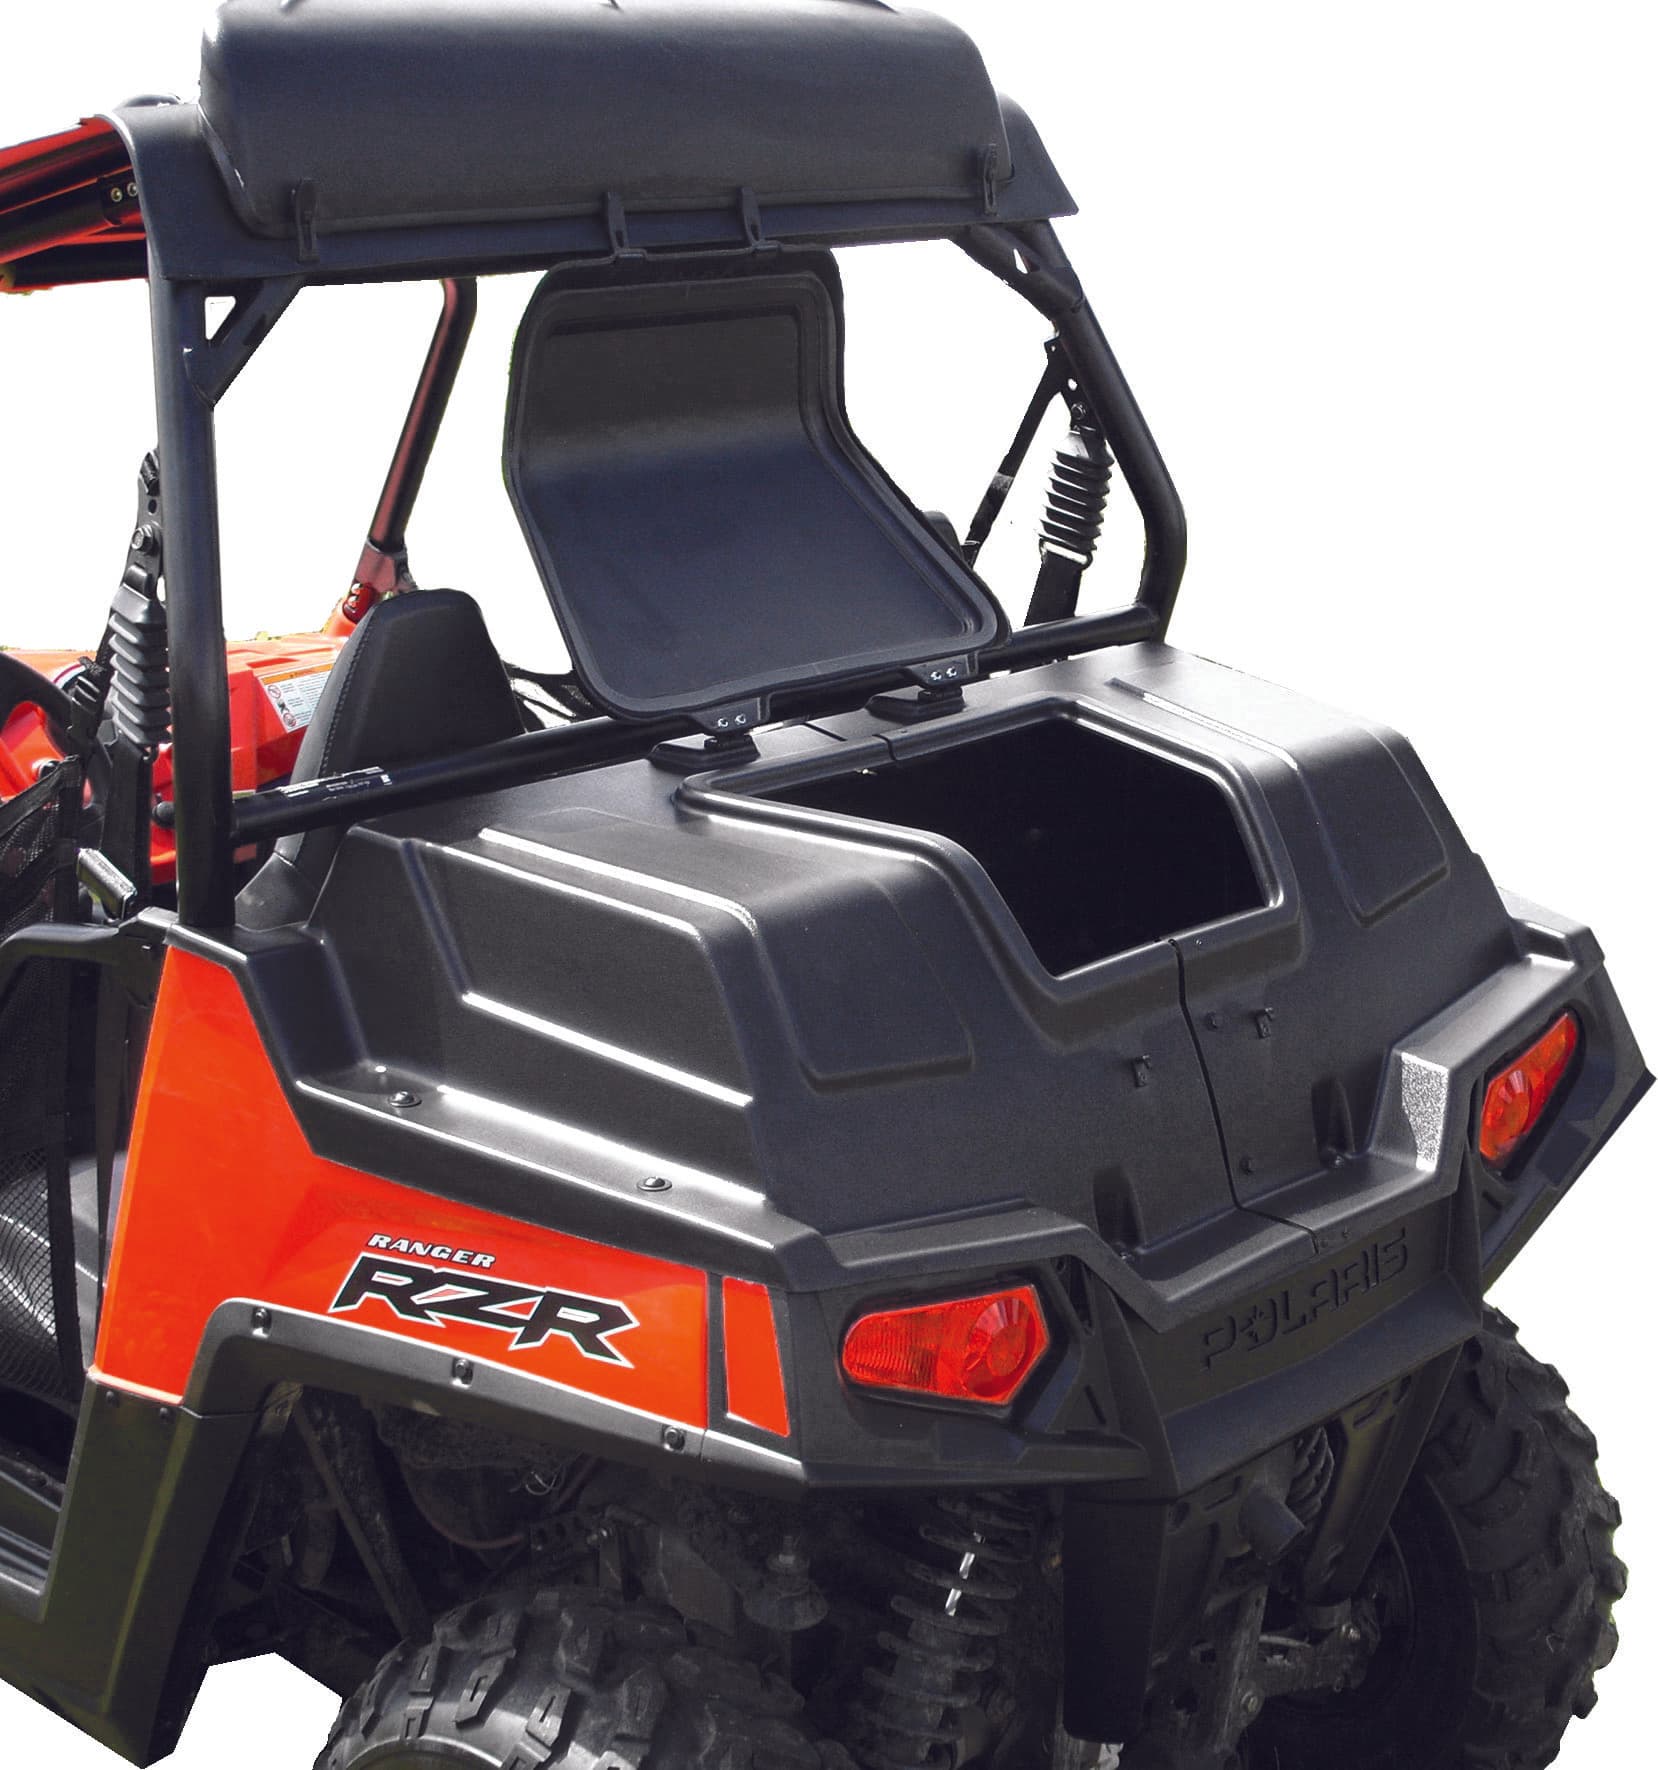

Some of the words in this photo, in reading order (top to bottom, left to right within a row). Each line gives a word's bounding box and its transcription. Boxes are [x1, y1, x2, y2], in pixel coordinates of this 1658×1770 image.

[367, 1233, 496, 1268] RANGER
[1200, 1226, 1409, 1370] POLARIS
[328, 1252, 640, 1369] RZR
